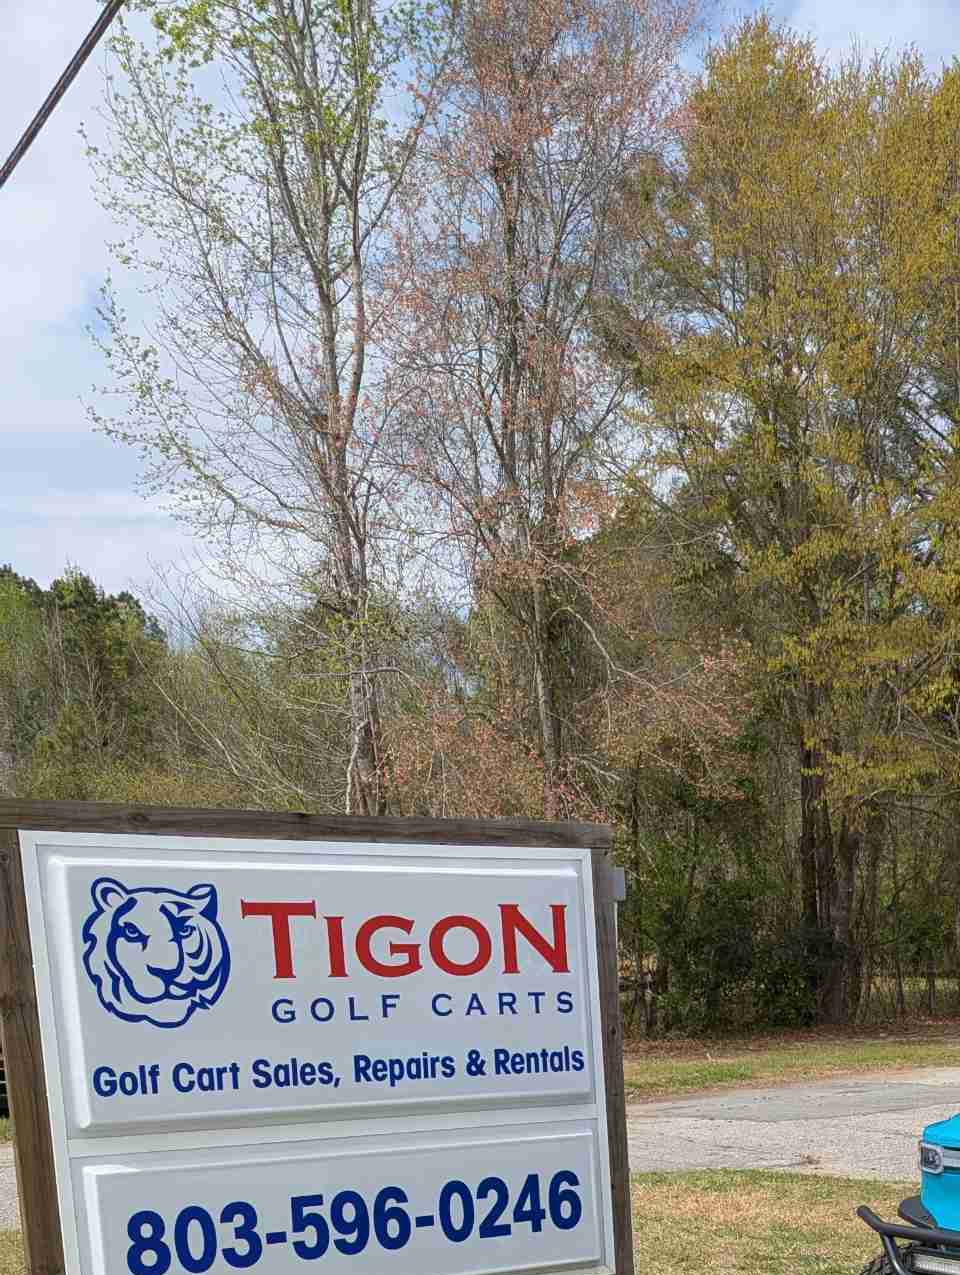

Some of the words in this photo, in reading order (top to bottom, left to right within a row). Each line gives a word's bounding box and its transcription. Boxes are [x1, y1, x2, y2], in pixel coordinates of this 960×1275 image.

[240, 900, 570, 979] TIGON
[271, 994, 402, 1024] GOLF
[431, 990, 575, 1018] CARTS
[92, 1063, 161, 1098] Golf
[171, 1062, 242, 1094] Cart
[251, 1057, 341, 1089] Sales,
[353, 1053, 458, 1088] Repairs
[465, 1048, 488, 1077] &
[493, 1045, 586, 1076] Rentals
